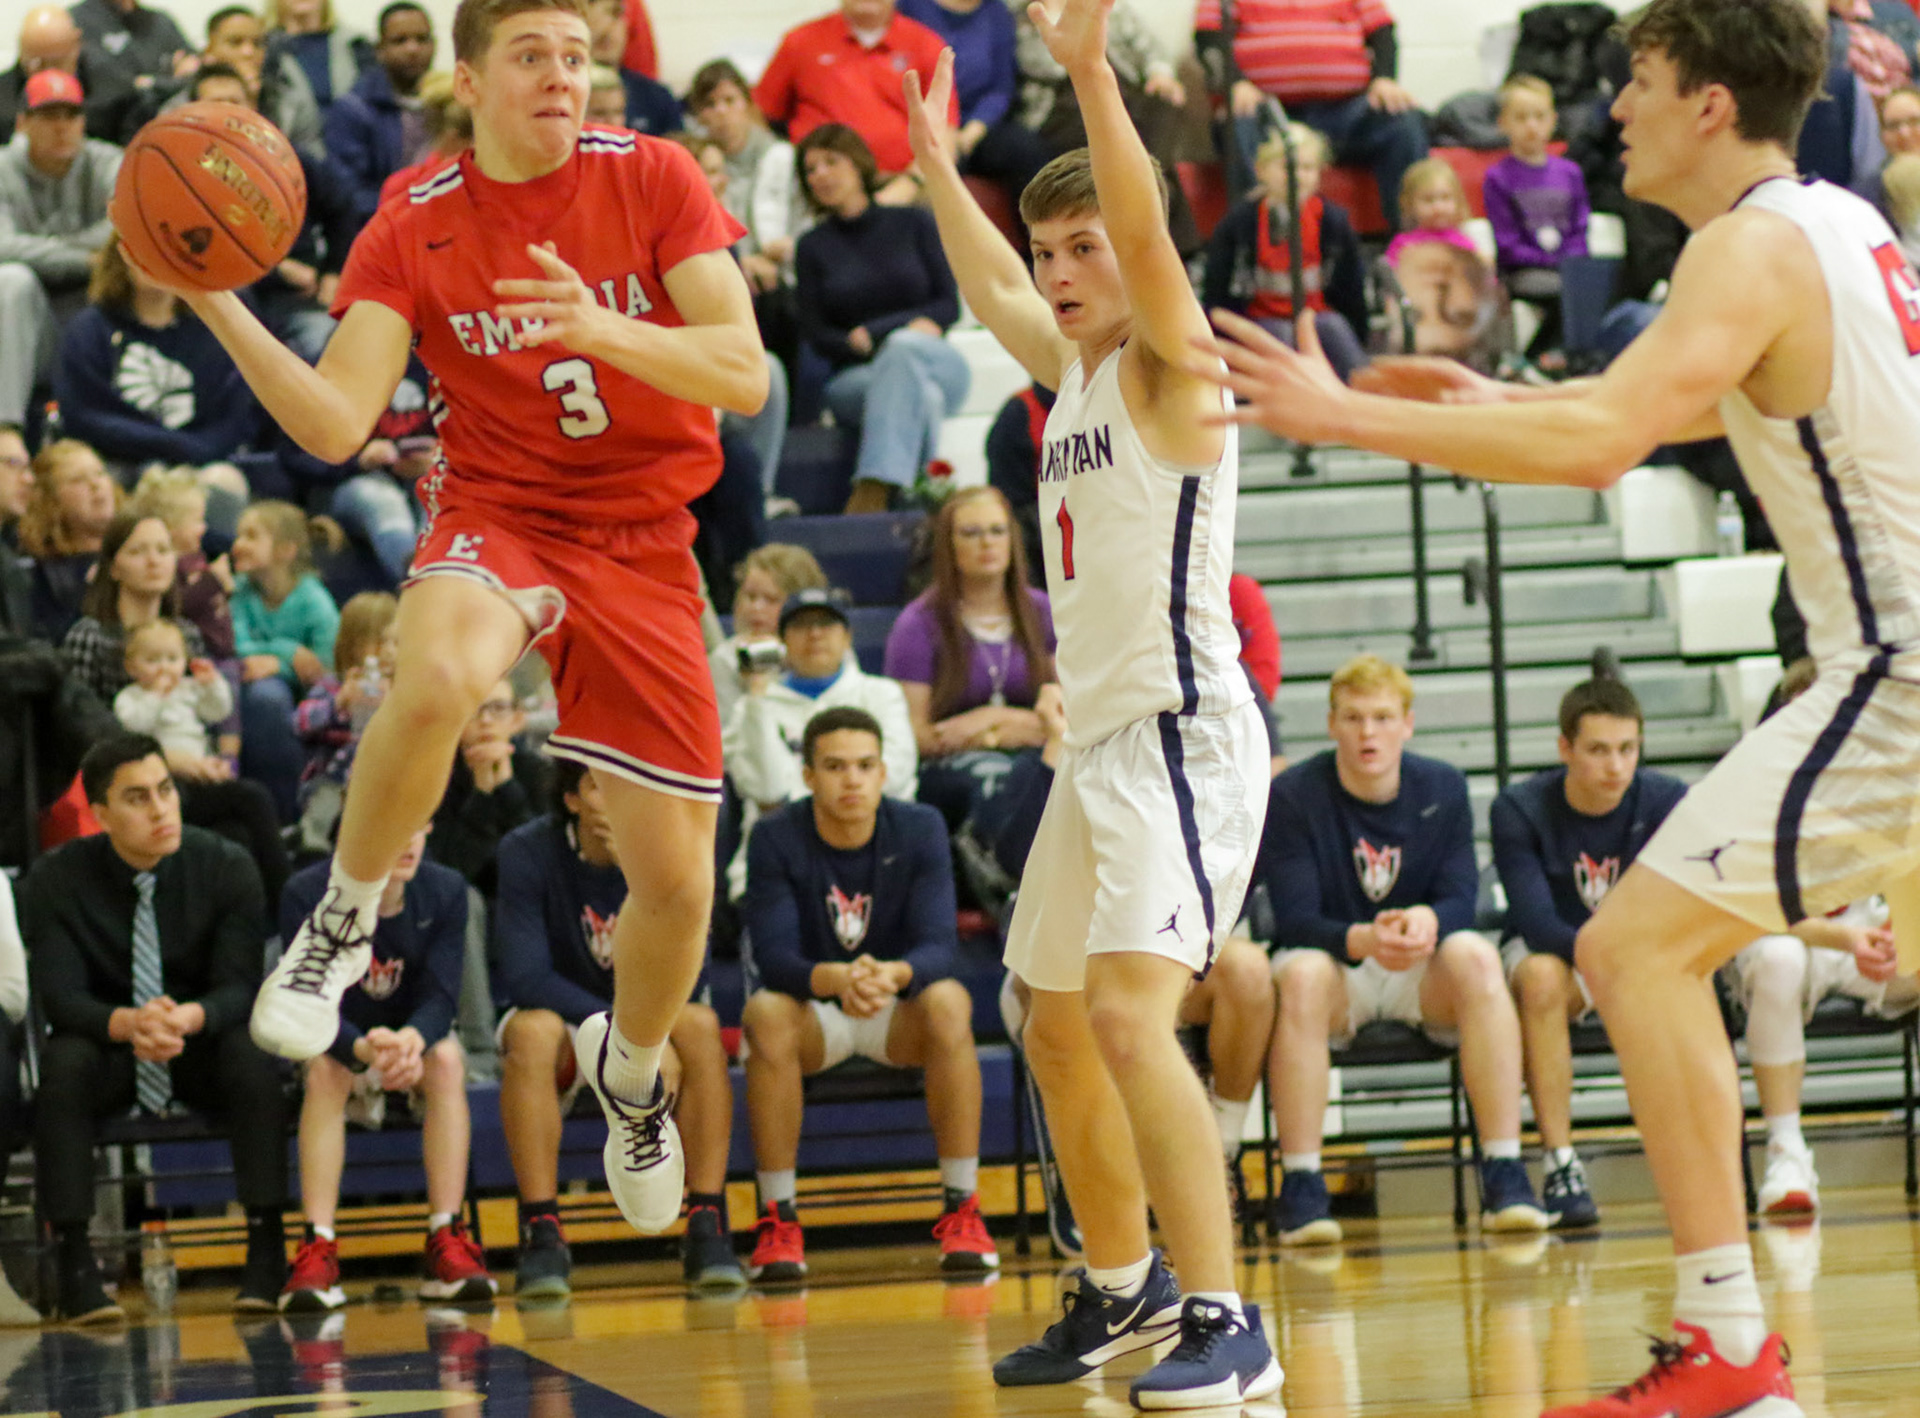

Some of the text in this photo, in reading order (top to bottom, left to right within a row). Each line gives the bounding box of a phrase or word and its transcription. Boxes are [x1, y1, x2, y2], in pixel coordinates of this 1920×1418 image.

[448, 272, 653, 356] EMIA
[541, 355, 612, 440] 3
[445, 532, 484, 561] E
[1056, 496, 1075, 581] 1
